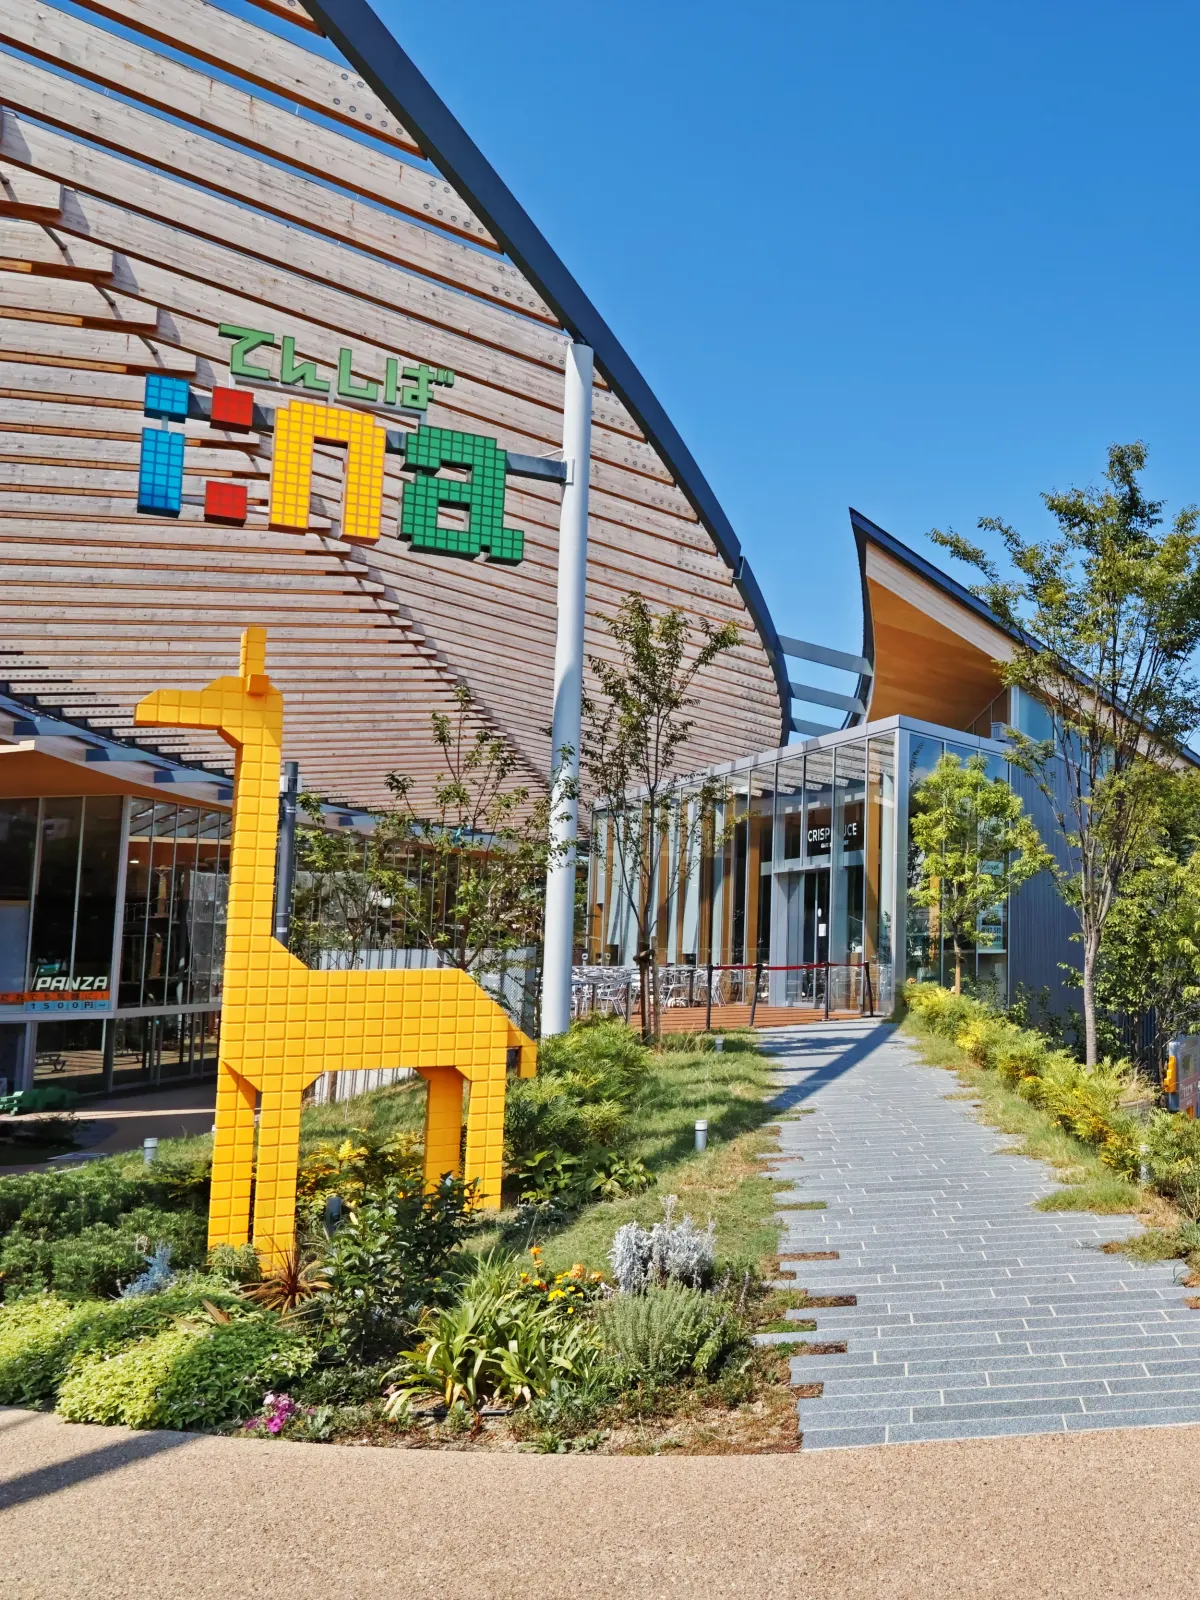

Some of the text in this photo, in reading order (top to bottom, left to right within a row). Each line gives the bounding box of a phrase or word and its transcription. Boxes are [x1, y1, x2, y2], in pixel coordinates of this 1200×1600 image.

[218, 322, 455, 411] てんしば
[35, 976, 108, 991] PANZA
